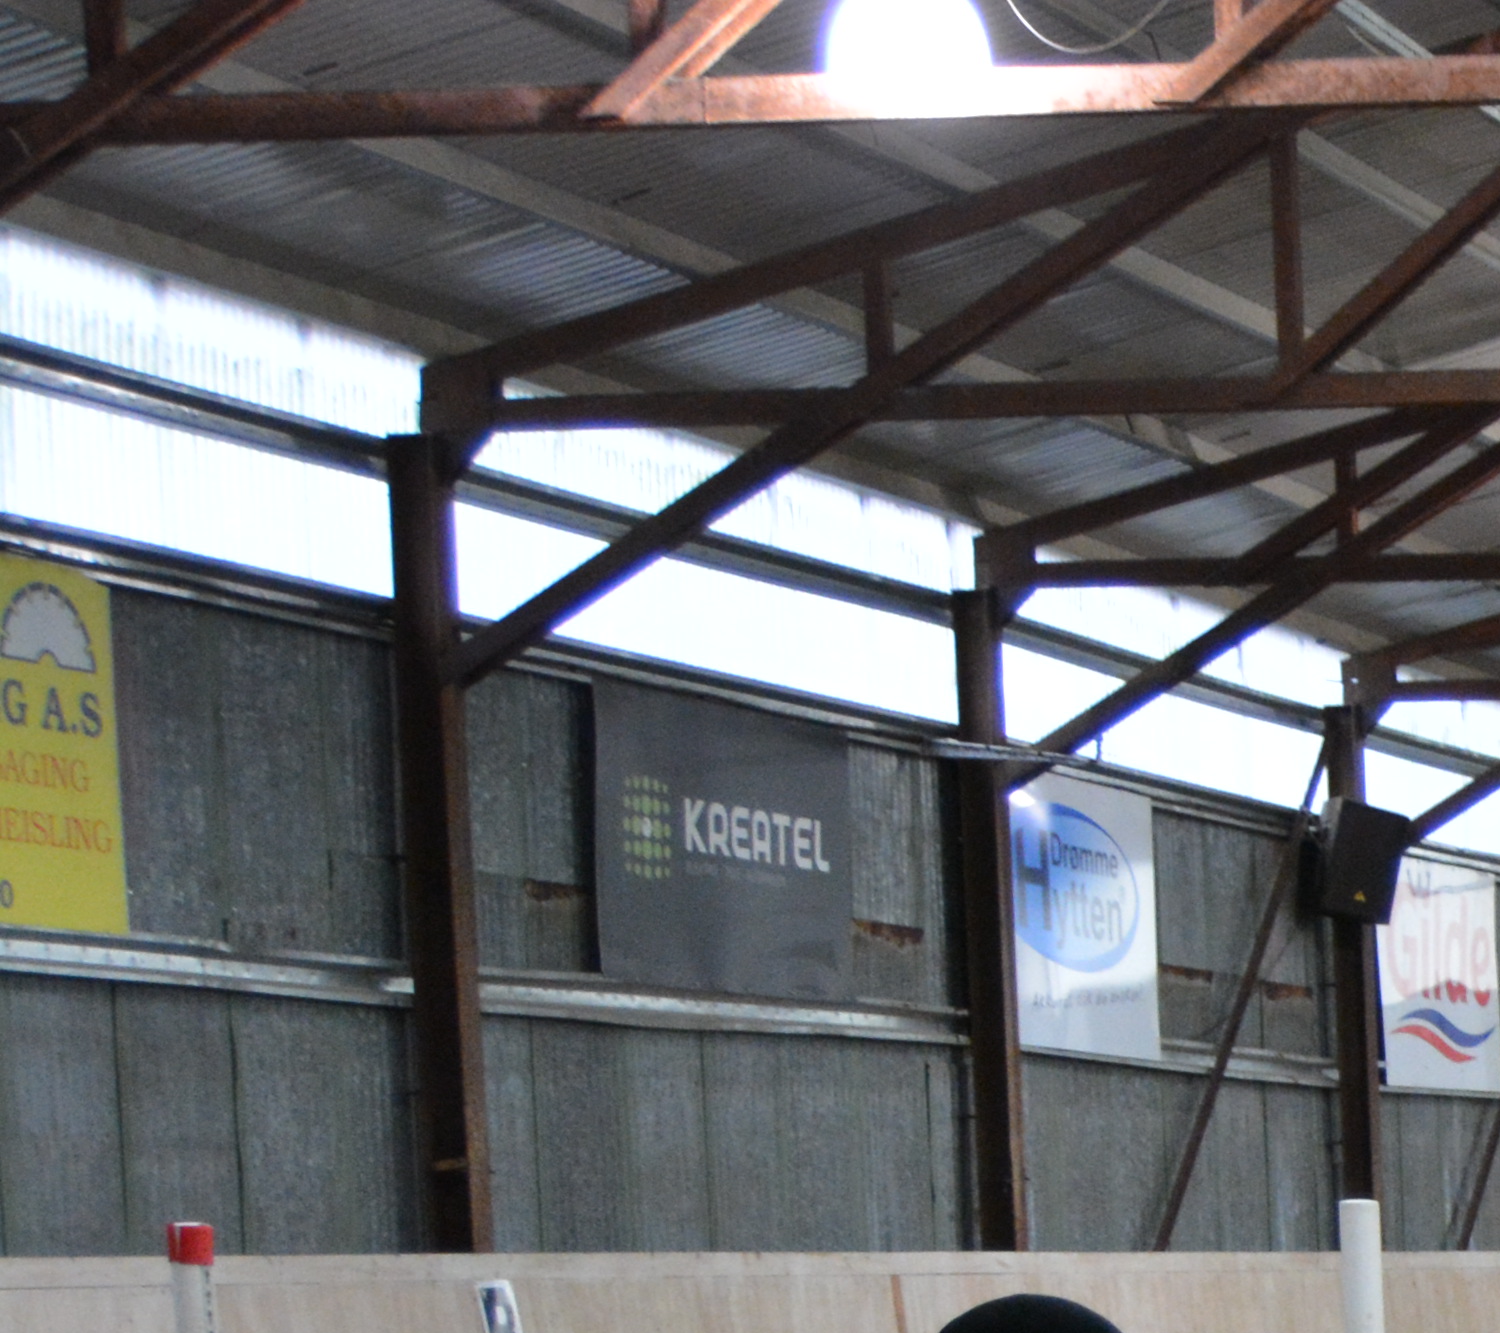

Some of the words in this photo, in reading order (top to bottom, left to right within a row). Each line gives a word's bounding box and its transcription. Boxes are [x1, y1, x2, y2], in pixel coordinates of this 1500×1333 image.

[0, 749, 90, 793] AGING
[684, 797, 830, 873] KREATEL
[1050, 831, 1119, 880] Drømme
[1015, 827, 1124, 949] Hytten
[1386, 881, 1491, 1007] Gilde
